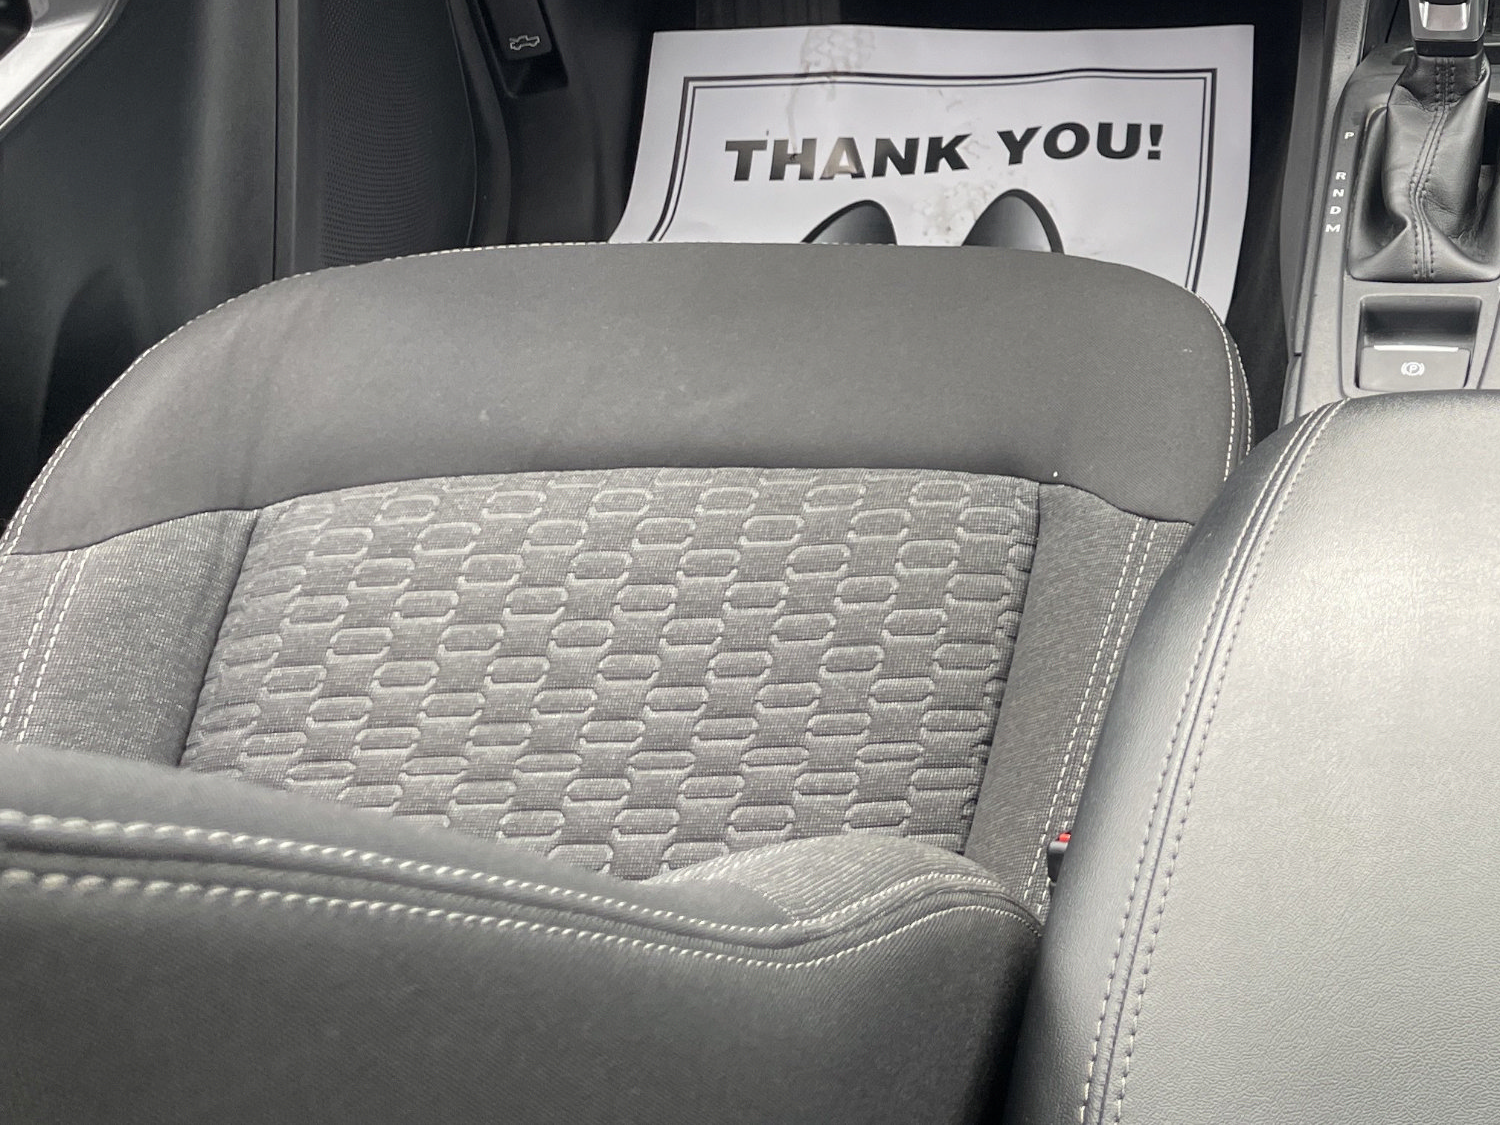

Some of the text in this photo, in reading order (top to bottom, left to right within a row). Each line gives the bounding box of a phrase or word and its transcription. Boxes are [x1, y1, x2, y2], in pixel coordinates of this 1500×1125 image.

[724, 122, 1164, 182] THANK YOU!
[1335, 171, 1347, 180] R
[1332, 189, 1344, 197] N
[1329, 206, 1341, 214] D
